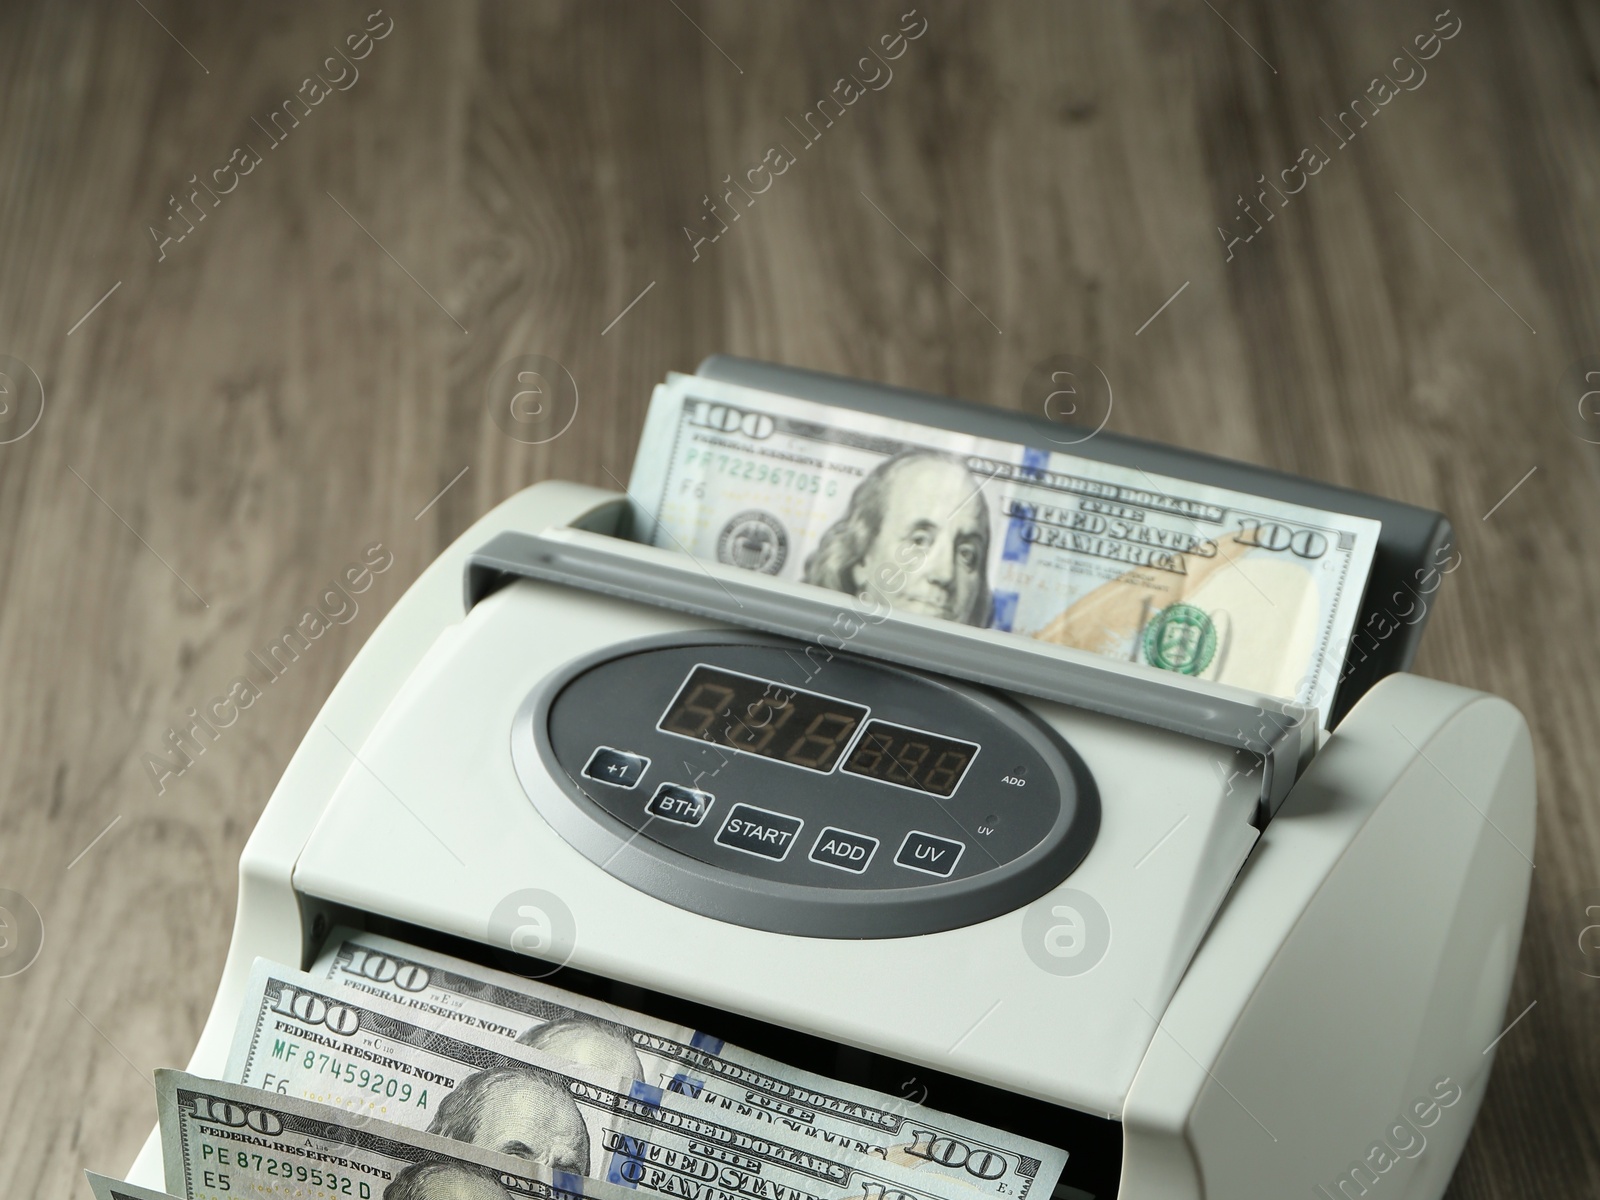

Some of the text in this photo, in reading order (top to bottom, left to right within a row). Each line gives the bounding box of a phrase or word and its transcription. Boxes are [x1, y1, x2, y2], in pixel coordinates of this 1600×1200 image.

[689, 401, 775, 440] 100
[716, 454, 822, 495] 72296705
[1233, 518, 1328, 559] 100
[607, 763, 629, 778] +1
[1001, 775, 1026, 787] ADD
[659, 796, 702, 818] BTH
[727, 818, 792, 847] START
[821, 839, 866, 861] ADD
[977, 825, 994, 836] UV
[914, 843, 946, 863] UV
[341, 950, 430, 992] 100
[271, 988, 360, 1036] 100
[343, 978, 518, 1039] FEDERAL RESERVE NOTE
[272, 1038, 428, 1109] MF 87459209 A
[274, 1020, 455, 1089] FEDERAL RESERVE NOTE
[633, 1033, 899, 1129] ONE HUNDRED DOLLARS
[189, 1097, 284, 1136] 100
[745, 1090, 816, 1125] THE
[569, 1082, 848, 1180] ONE HUNDRED DOLLARS
[200, 1125, 272, 1149] FEDERAL
[272, 1141, 349, 1167] RESERVE
[349, 1161, 392, 1181] NOTE
[202, 1143, 371, 1200] PE 87299532 D
[602, 1128, 718, 1183] UNITED
[688, 1140, 762, 1174] THE
[904, 1130, 1007, 1180] 100
[204, 1171, 231, 1191] E5
[500, 1174, 547, 1196] ONE
[621, 1160, 665, 1191] OF
